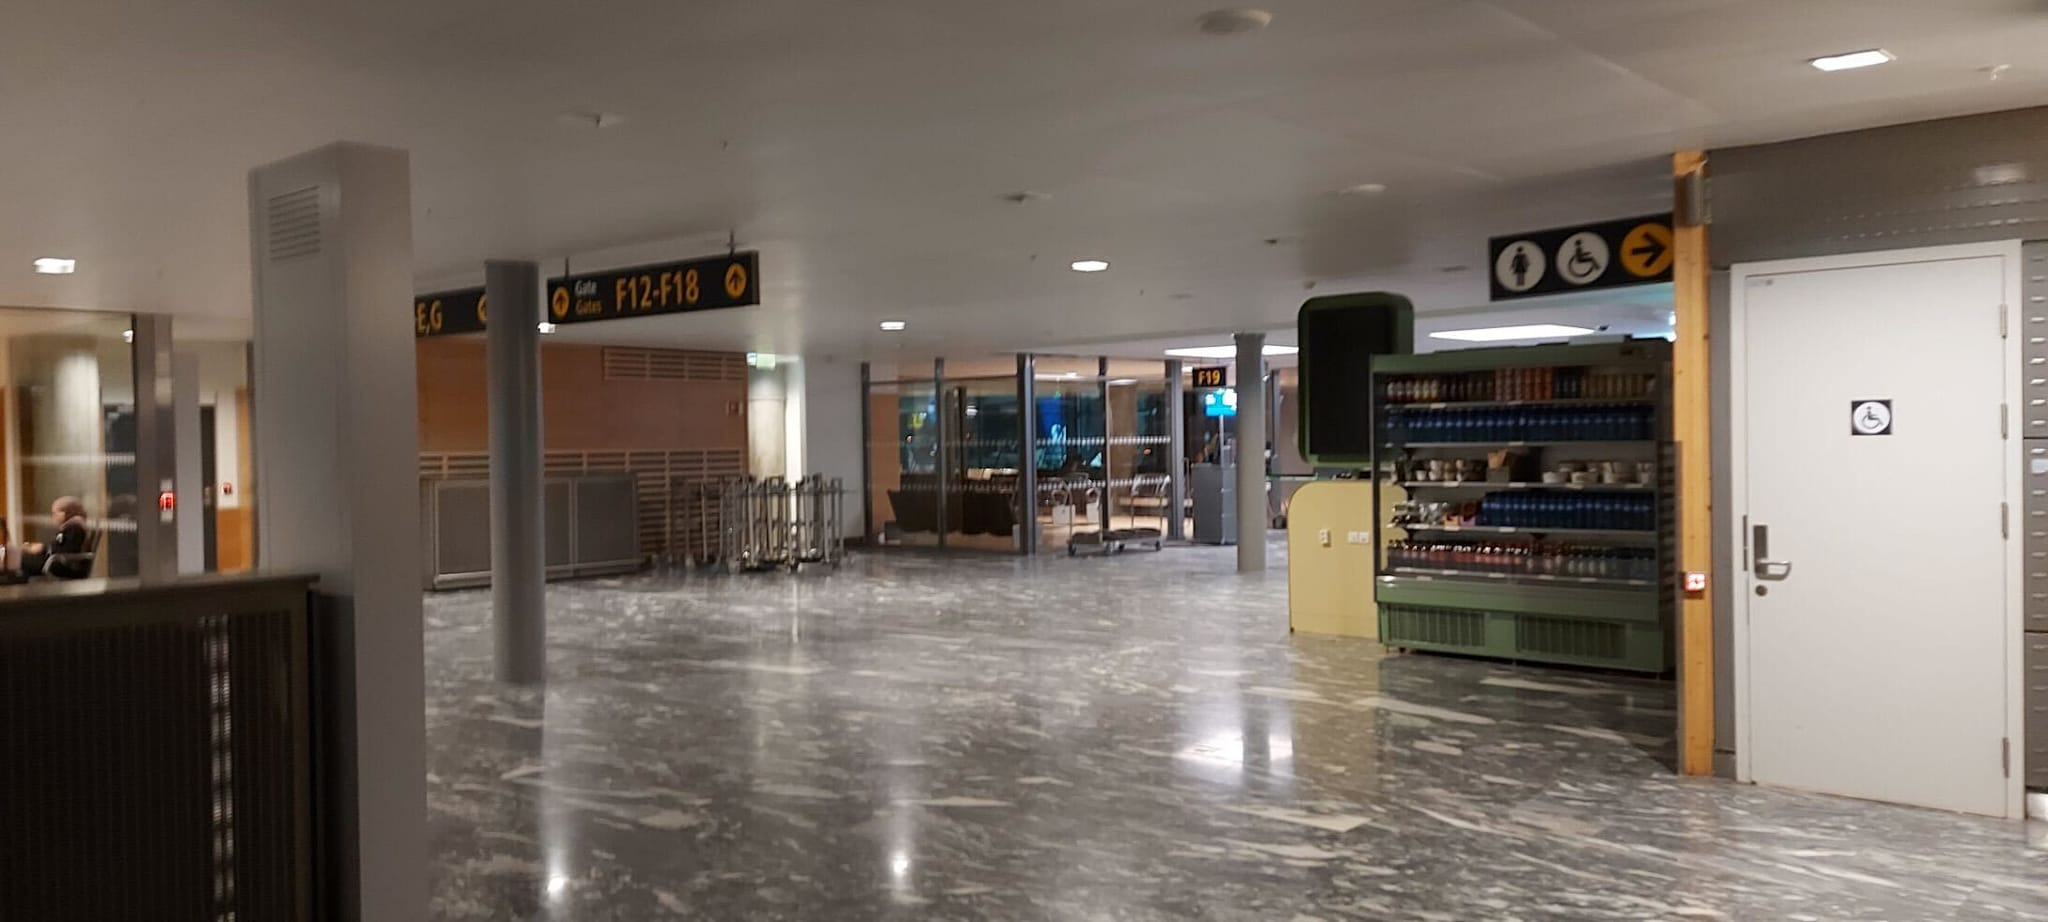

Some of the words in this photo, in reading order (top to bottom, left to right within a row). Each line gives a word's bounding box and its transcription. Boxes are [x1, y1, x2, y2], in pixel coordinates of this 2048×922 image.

[574, 280, 597, 297] Gate
[615, 269, 699, 312] F12-F18
[575, 299, 602, 315] Gates
[1198, 370, 1221, 385] F19
